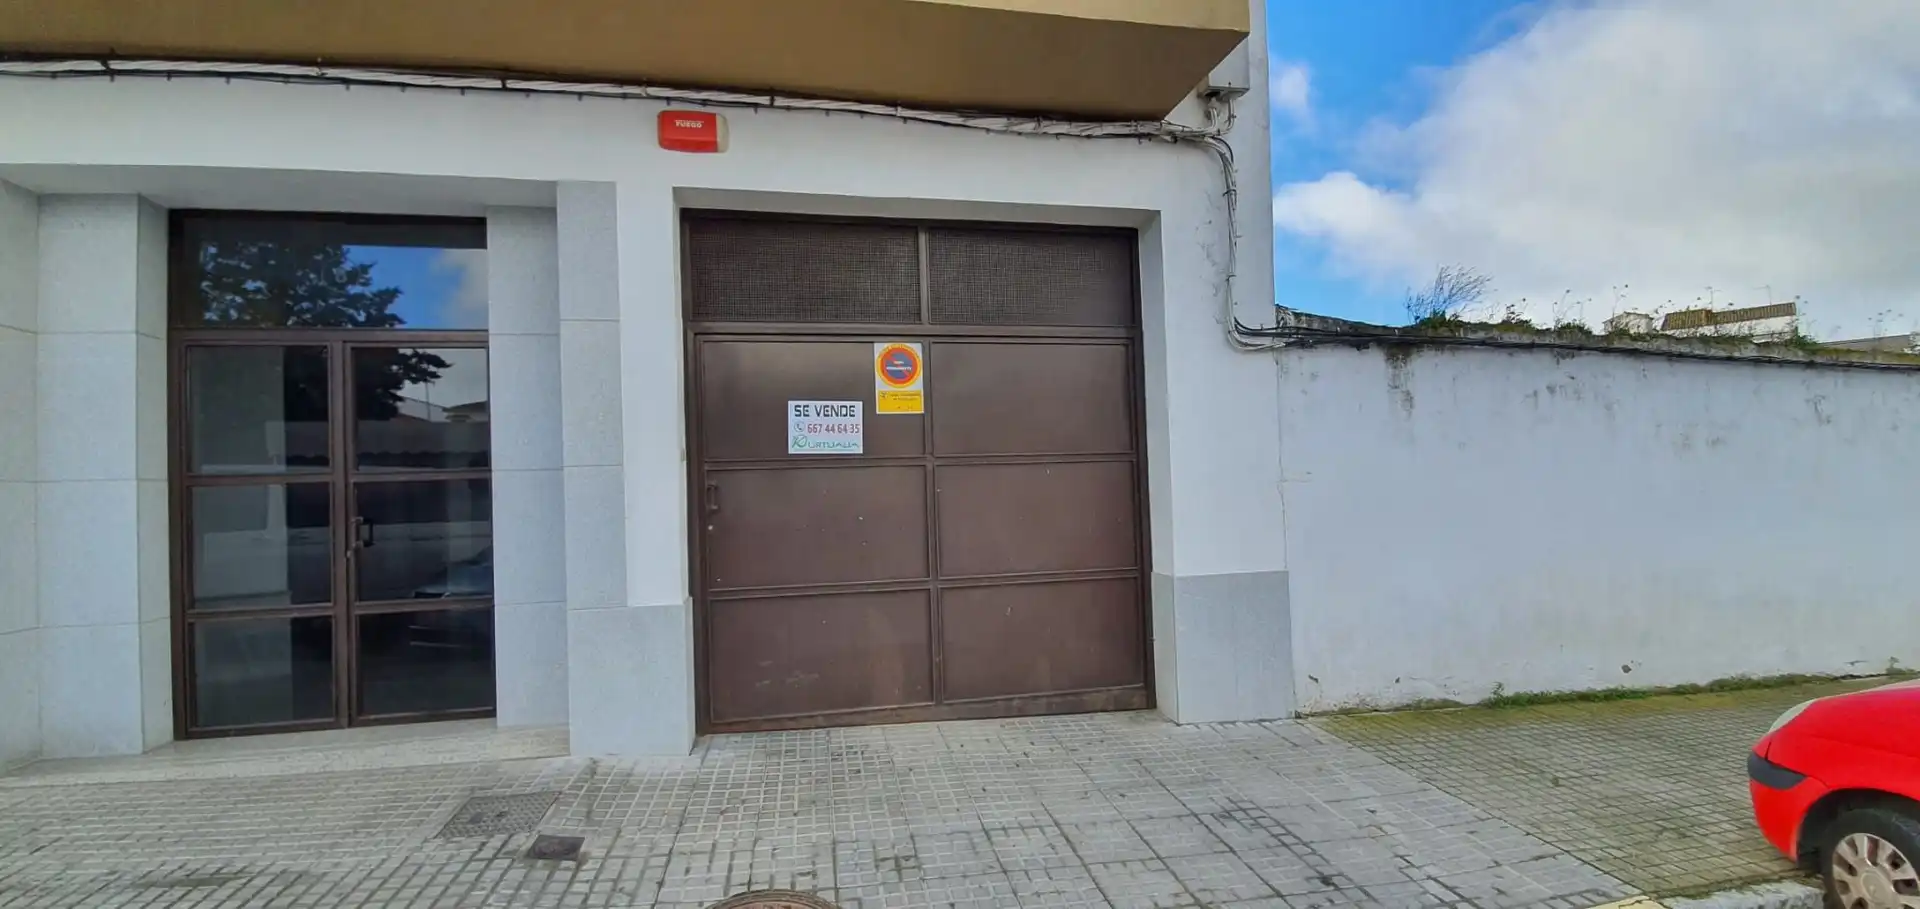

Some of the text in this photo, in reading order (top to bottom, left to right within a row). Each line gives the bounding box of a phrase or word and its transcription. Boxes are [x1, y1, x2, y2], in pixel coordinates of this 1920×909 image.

[794, 404, 856, 418] SE VENDE
[807, 423, 860, 434] 667 44 64 35
